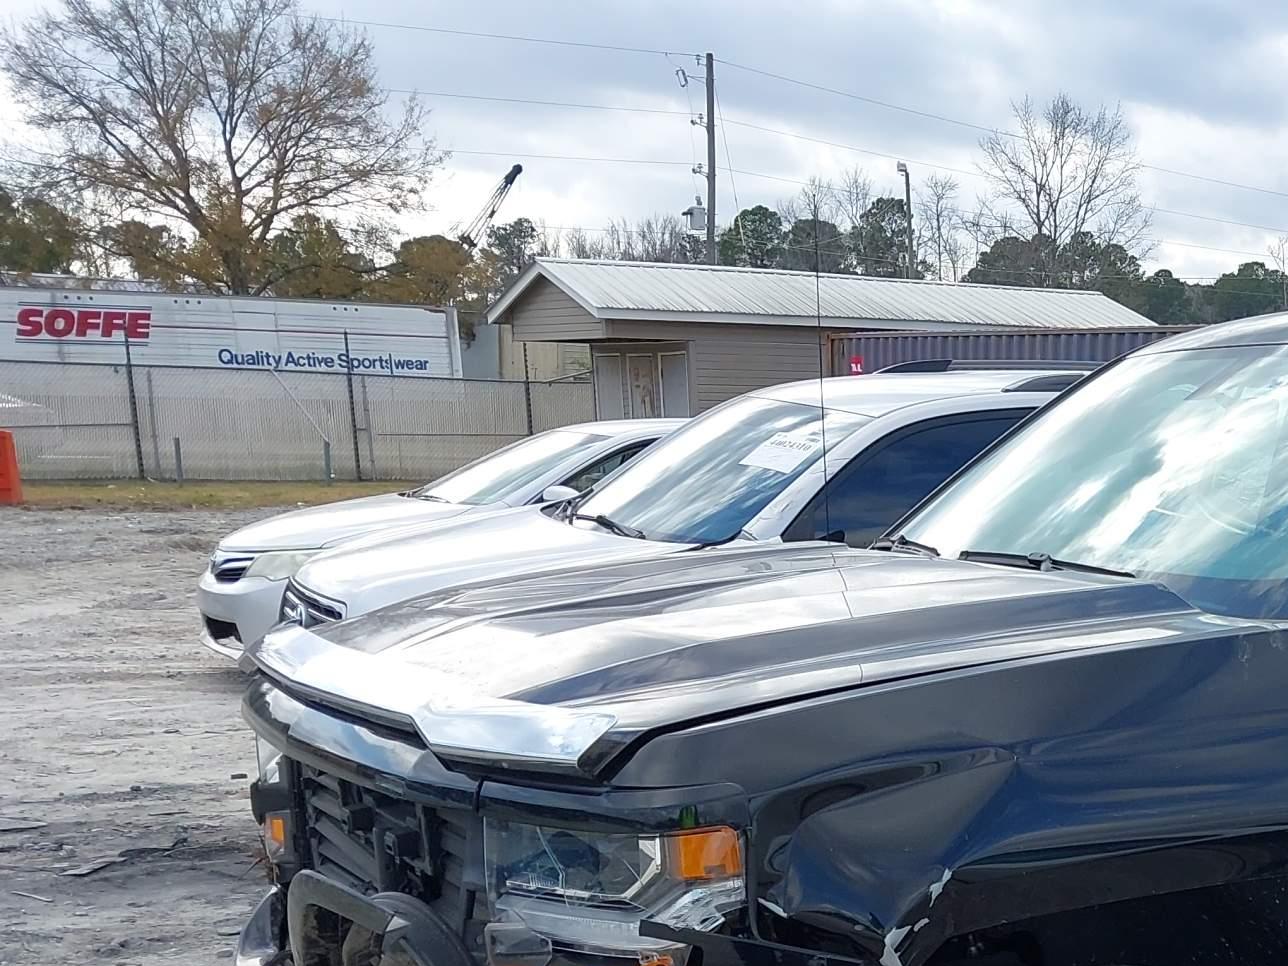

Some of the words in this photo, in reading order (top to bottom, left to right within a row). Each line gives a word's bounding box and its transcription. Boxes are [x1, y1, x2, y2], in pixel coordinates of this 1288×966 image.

[16, 308, 151, 339] SOFFE
[218, 348, 282, 369] Quality
[284, 351, 335, 368] Active
